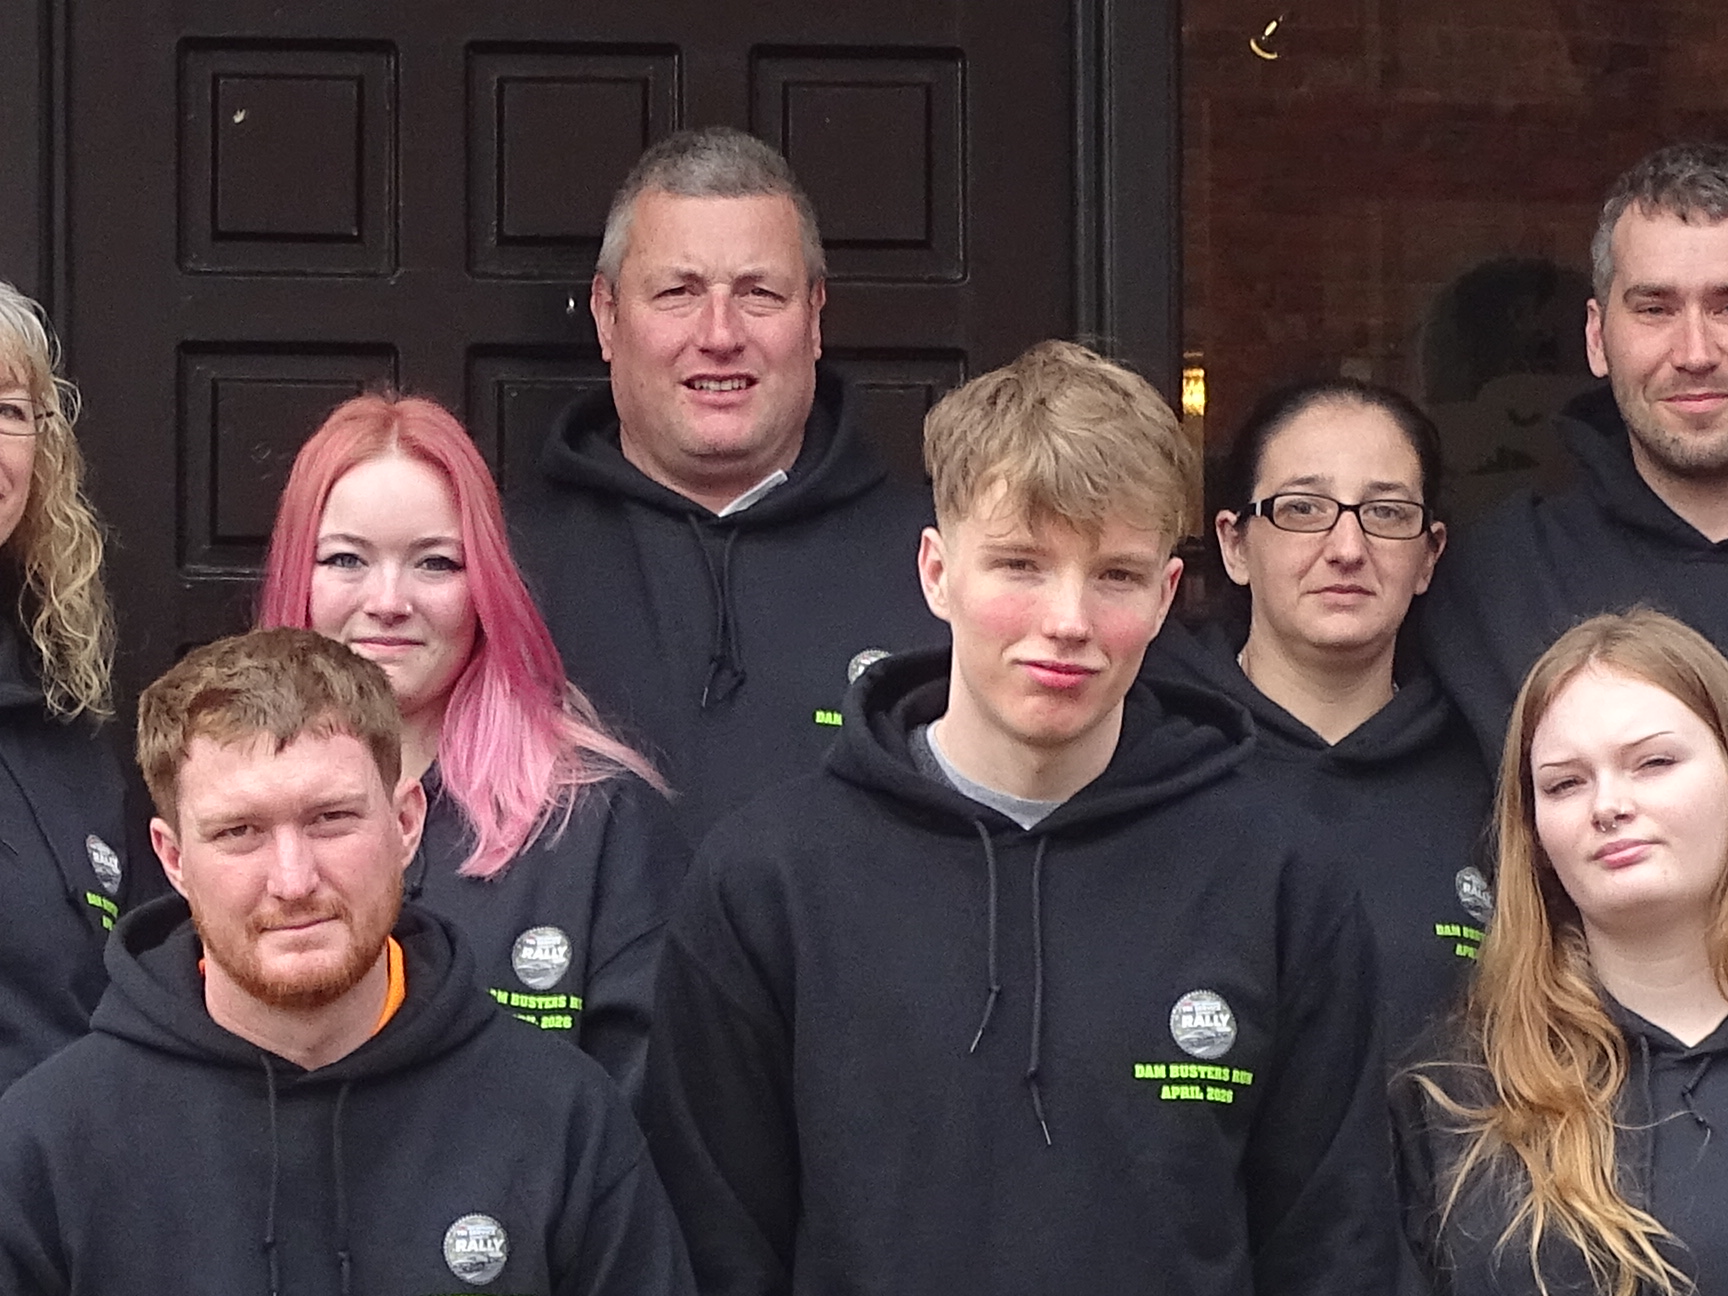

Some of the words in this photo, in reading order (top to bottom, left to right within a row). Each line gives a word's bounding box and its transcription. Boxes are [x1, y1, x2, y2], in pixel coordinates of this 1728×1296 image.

[521, 945, 568, 961] RALLY
[510, 991, 567, 1010] BUSTERS
[1181, 1012, 1231, 1029] RALLY
[1134, 1063, 1166, 1079] DAM
[1169, 1064, 1230, 1082] BUSTERS
[1231, 1068, 1254, 1086] RUN
[1160, 1085, 1204, 1101] APRIL
[1206, 1086, 1234, 1103] 2026
[455, 1237, 505, 1253] RALLY
